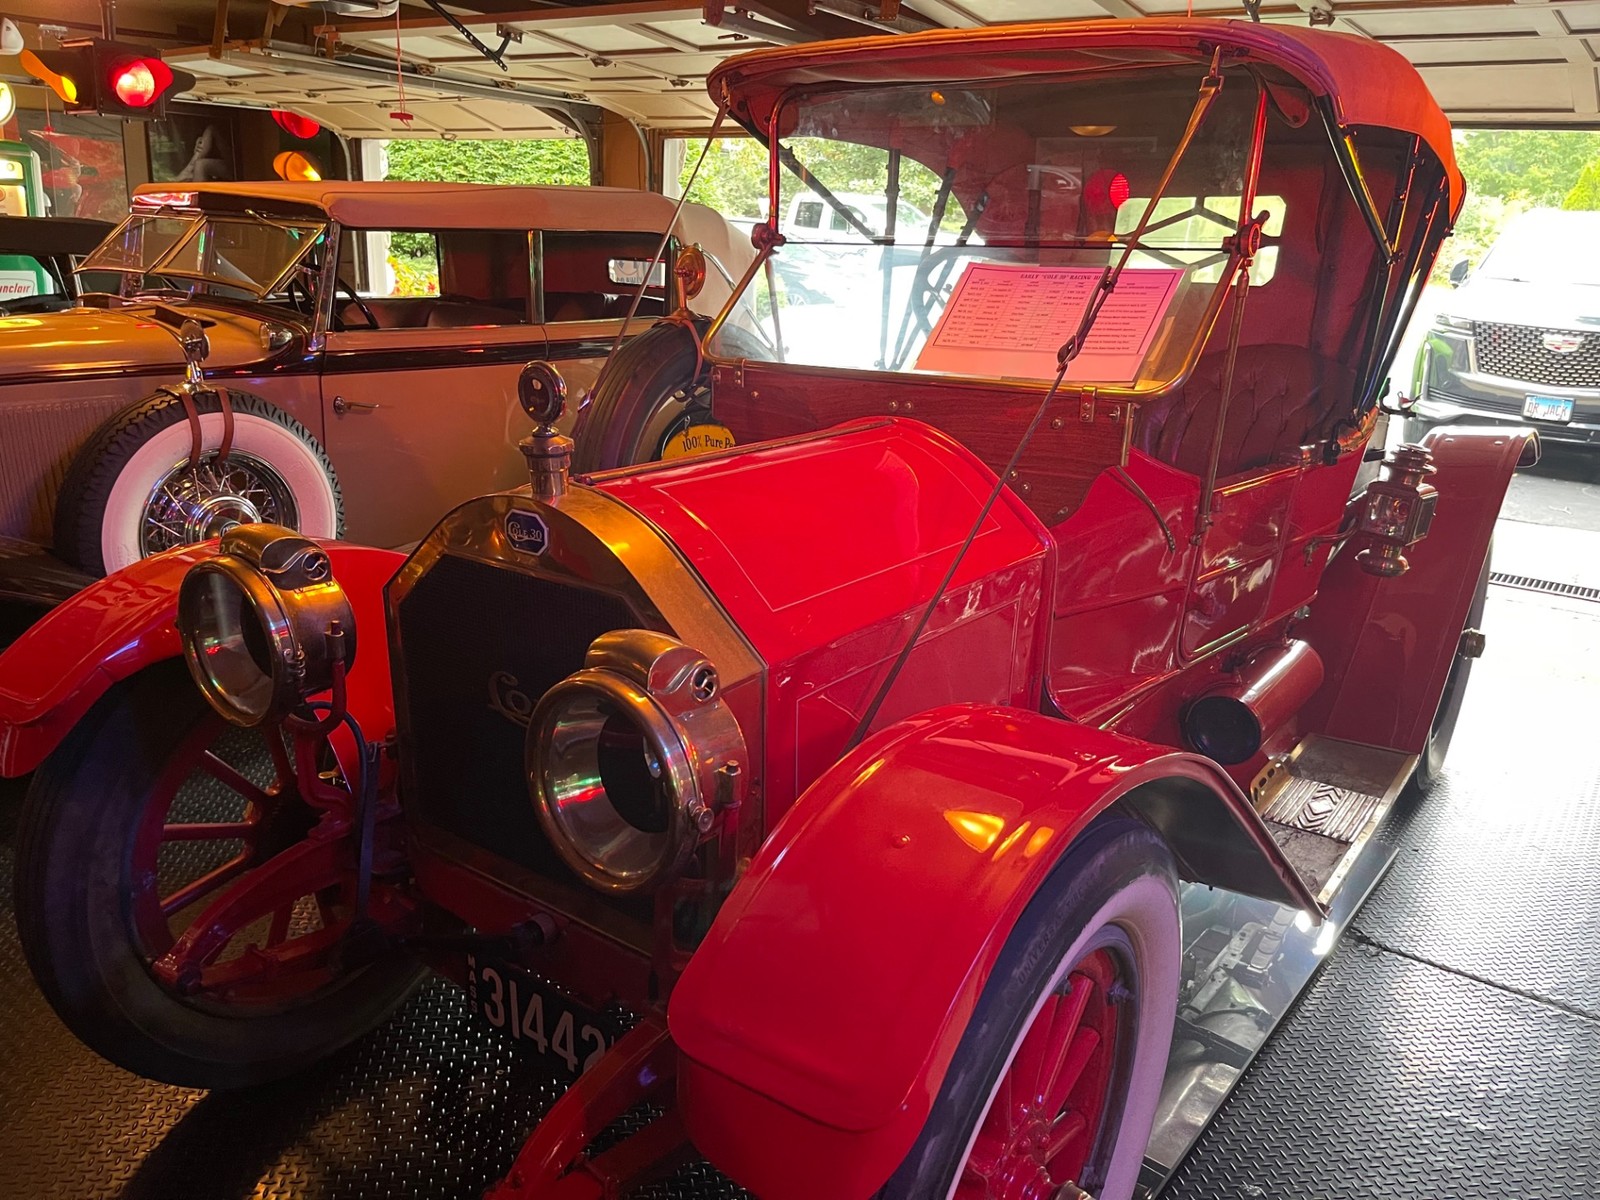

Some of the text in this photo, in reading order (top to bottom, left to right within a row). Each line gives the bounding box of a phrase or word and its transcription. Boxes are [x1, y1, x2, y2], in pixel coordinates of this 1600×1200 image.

[0, 283, 31, 294] inclair
[1526, 402, 1569, 417] DR JACK
[682, 435, 702, 452] 100%
[704, 434, 723, 448] Pure
[530, 528, 542, 540] 30
[482, 967, 606, 1074] 31442
